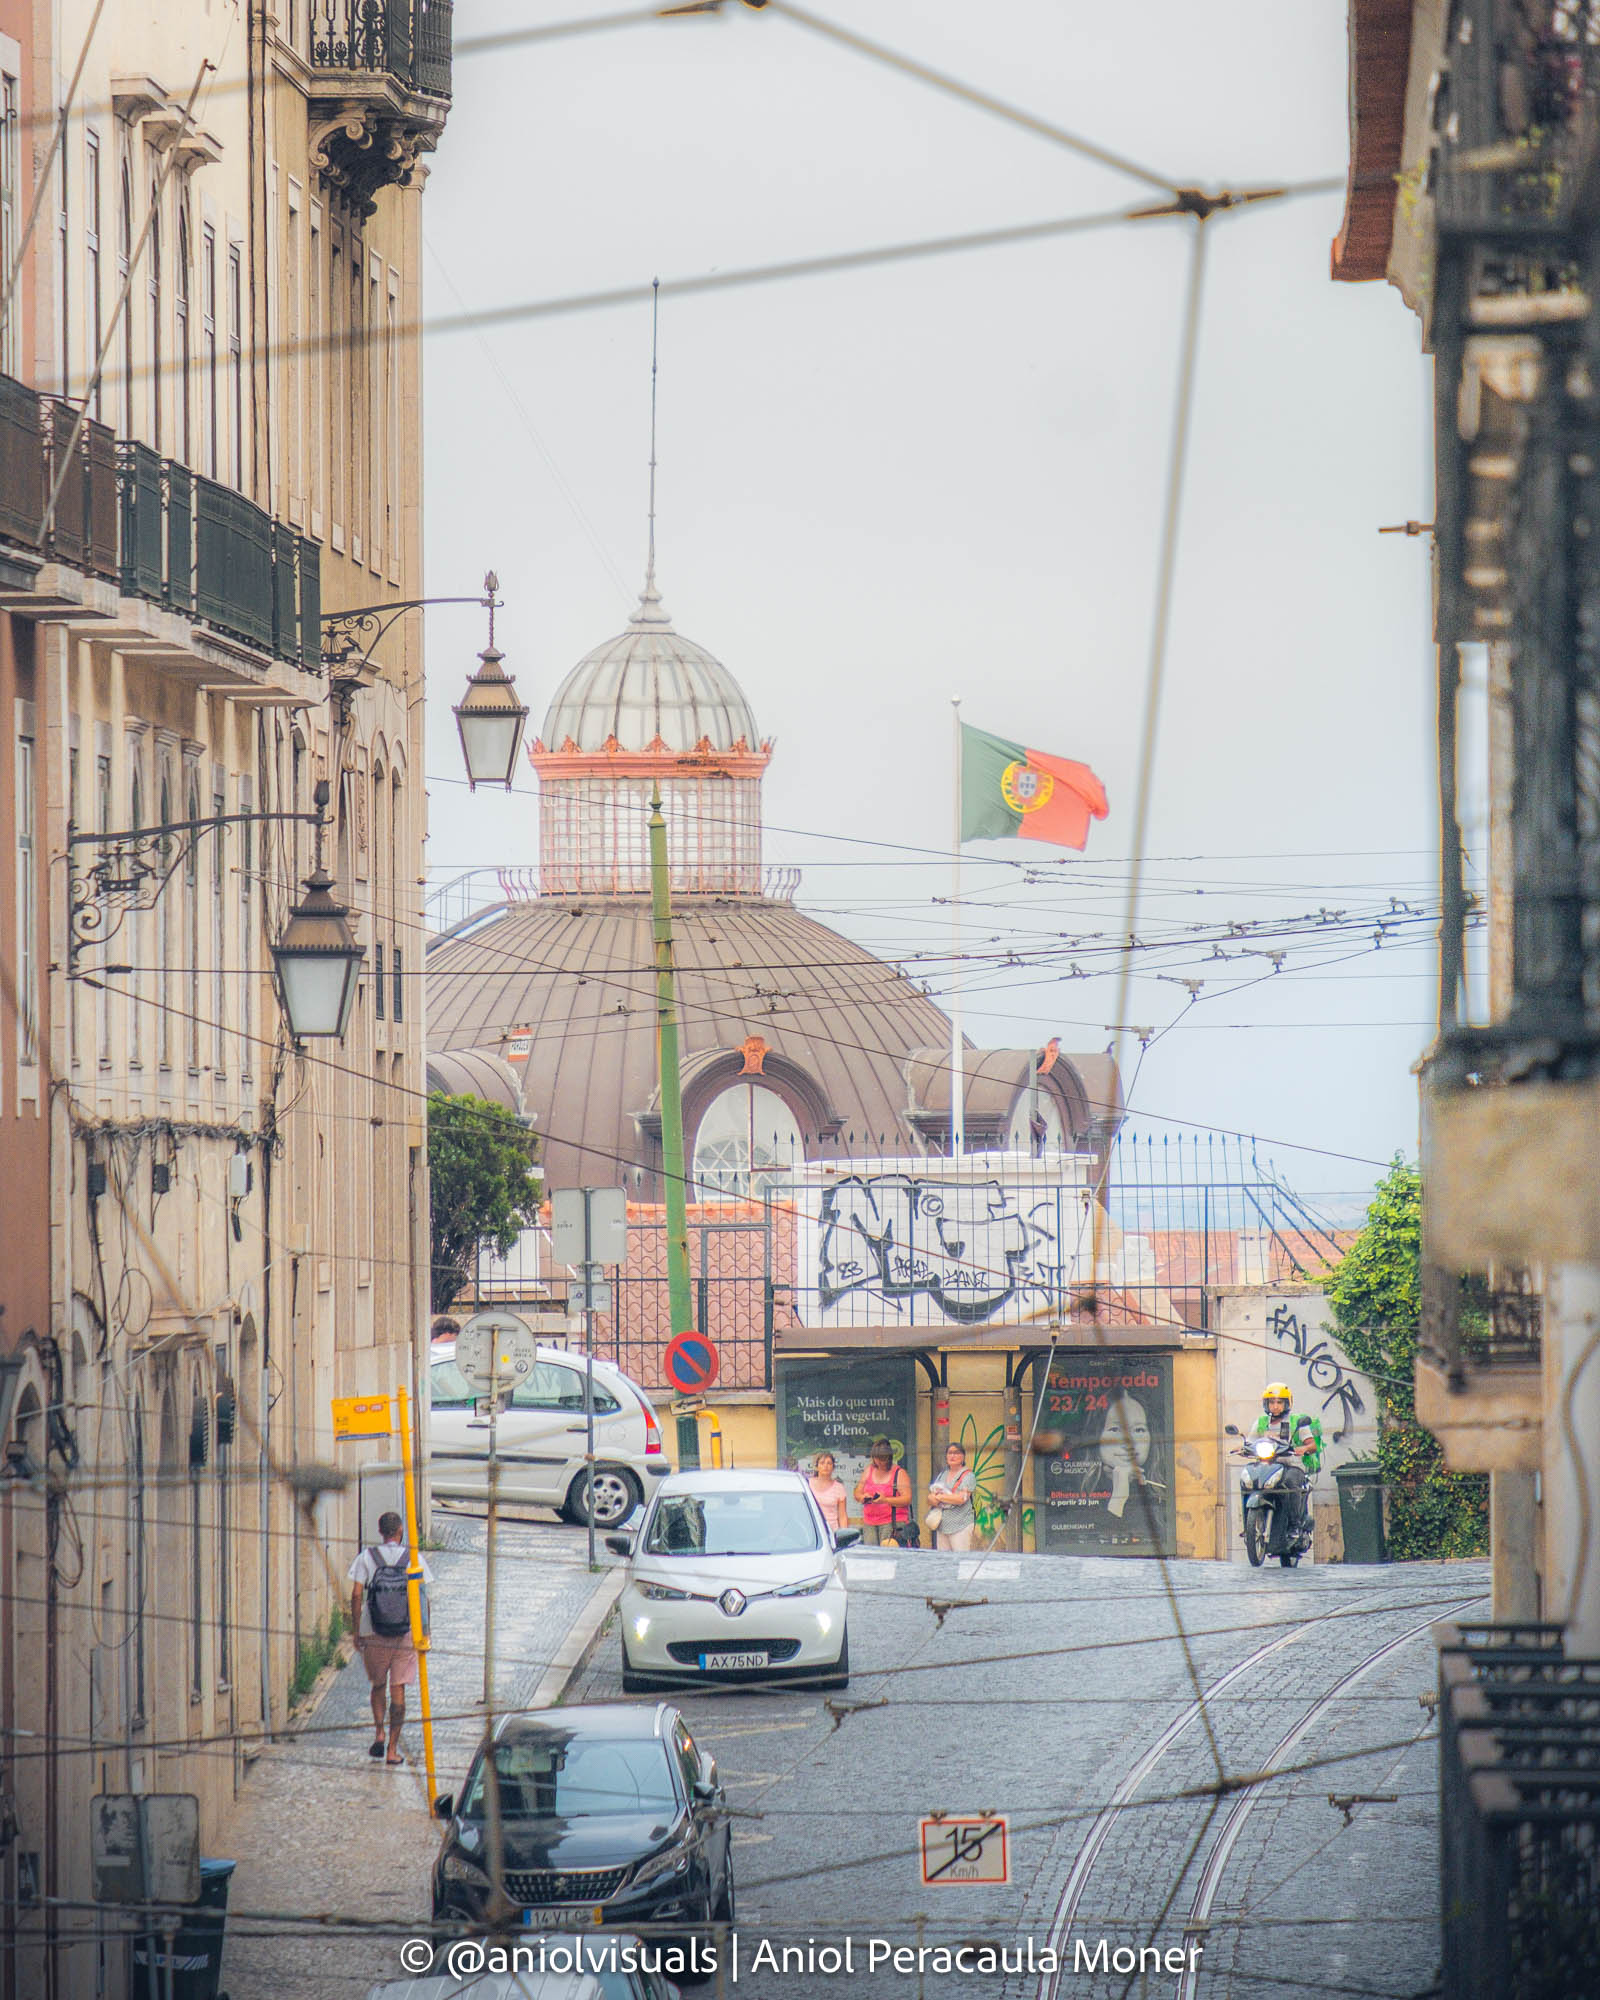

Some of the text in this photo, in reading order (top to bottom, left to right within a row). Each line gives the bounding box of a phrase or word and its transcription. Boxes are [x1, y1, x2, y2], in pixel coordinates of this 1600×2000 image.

[1048, 1371, 1159, 1392] Temporada
[797, 1396, 895, 1410] Mais do que uma
[803, 1410, 842, 1422] bebida
[824, 1424, 869, 1436] é Pleno.
[1057, 1499, 1076, 1508] partir
[1088, 1499, 1100, 1507] jun
[945, 1826, 983, 1863] 15
